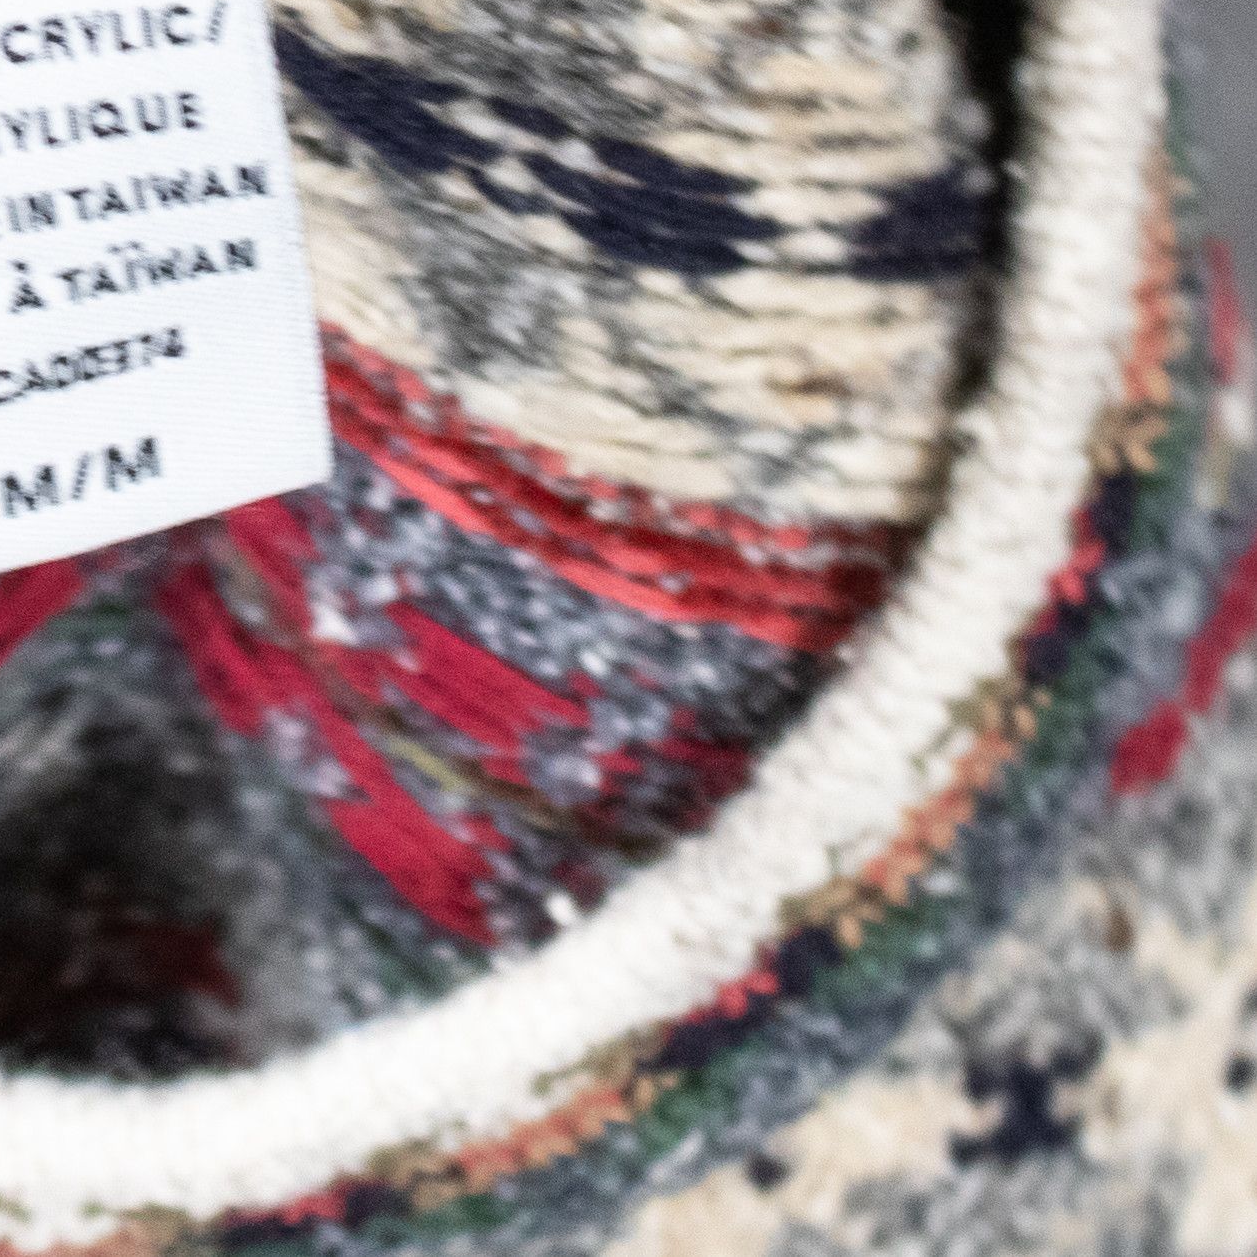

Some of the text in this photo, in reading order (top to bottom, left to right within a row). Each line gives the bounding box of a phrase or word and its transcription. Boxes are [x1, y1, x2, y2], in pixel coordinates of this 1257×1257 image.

[6, 192, 59, 233] IN
[65, 164, 271, 221] TAIWAN
[9, 259, 47, 315] À
